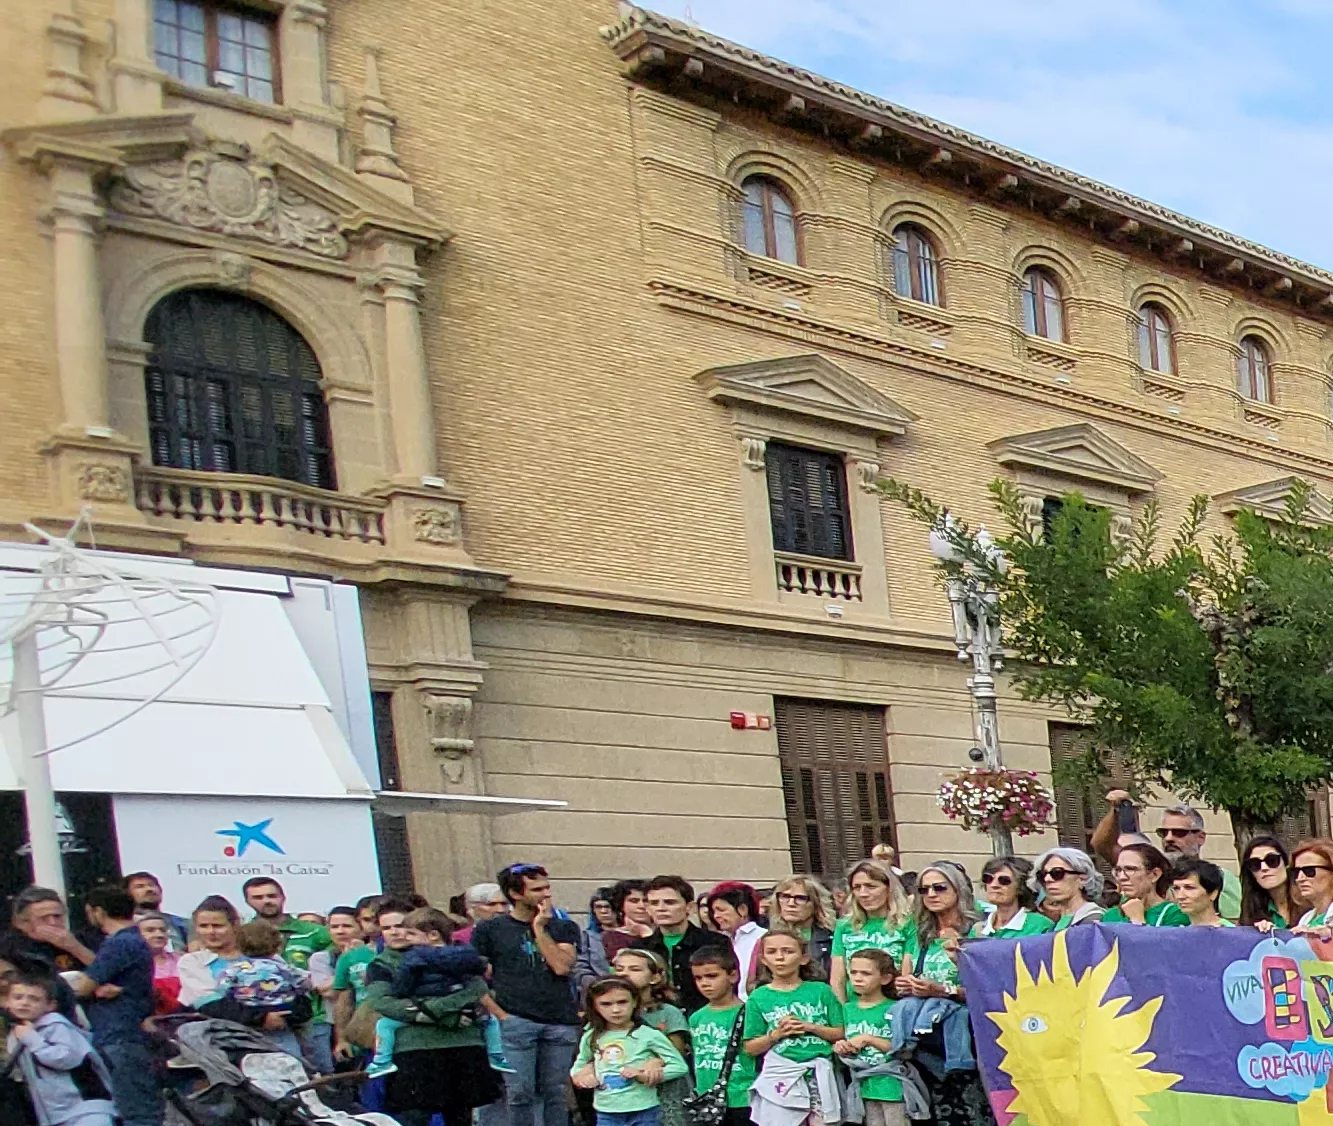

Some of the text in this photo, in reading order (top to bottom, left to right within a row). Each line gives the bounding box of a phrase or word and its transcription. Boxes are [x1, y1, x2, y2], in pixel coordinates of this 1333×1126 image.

[177, 862, 261, 876] Fundación
[1227, 974, 1264, 1004] VIVA
[1249, 1048, 1333, 1081] CREATIVA
